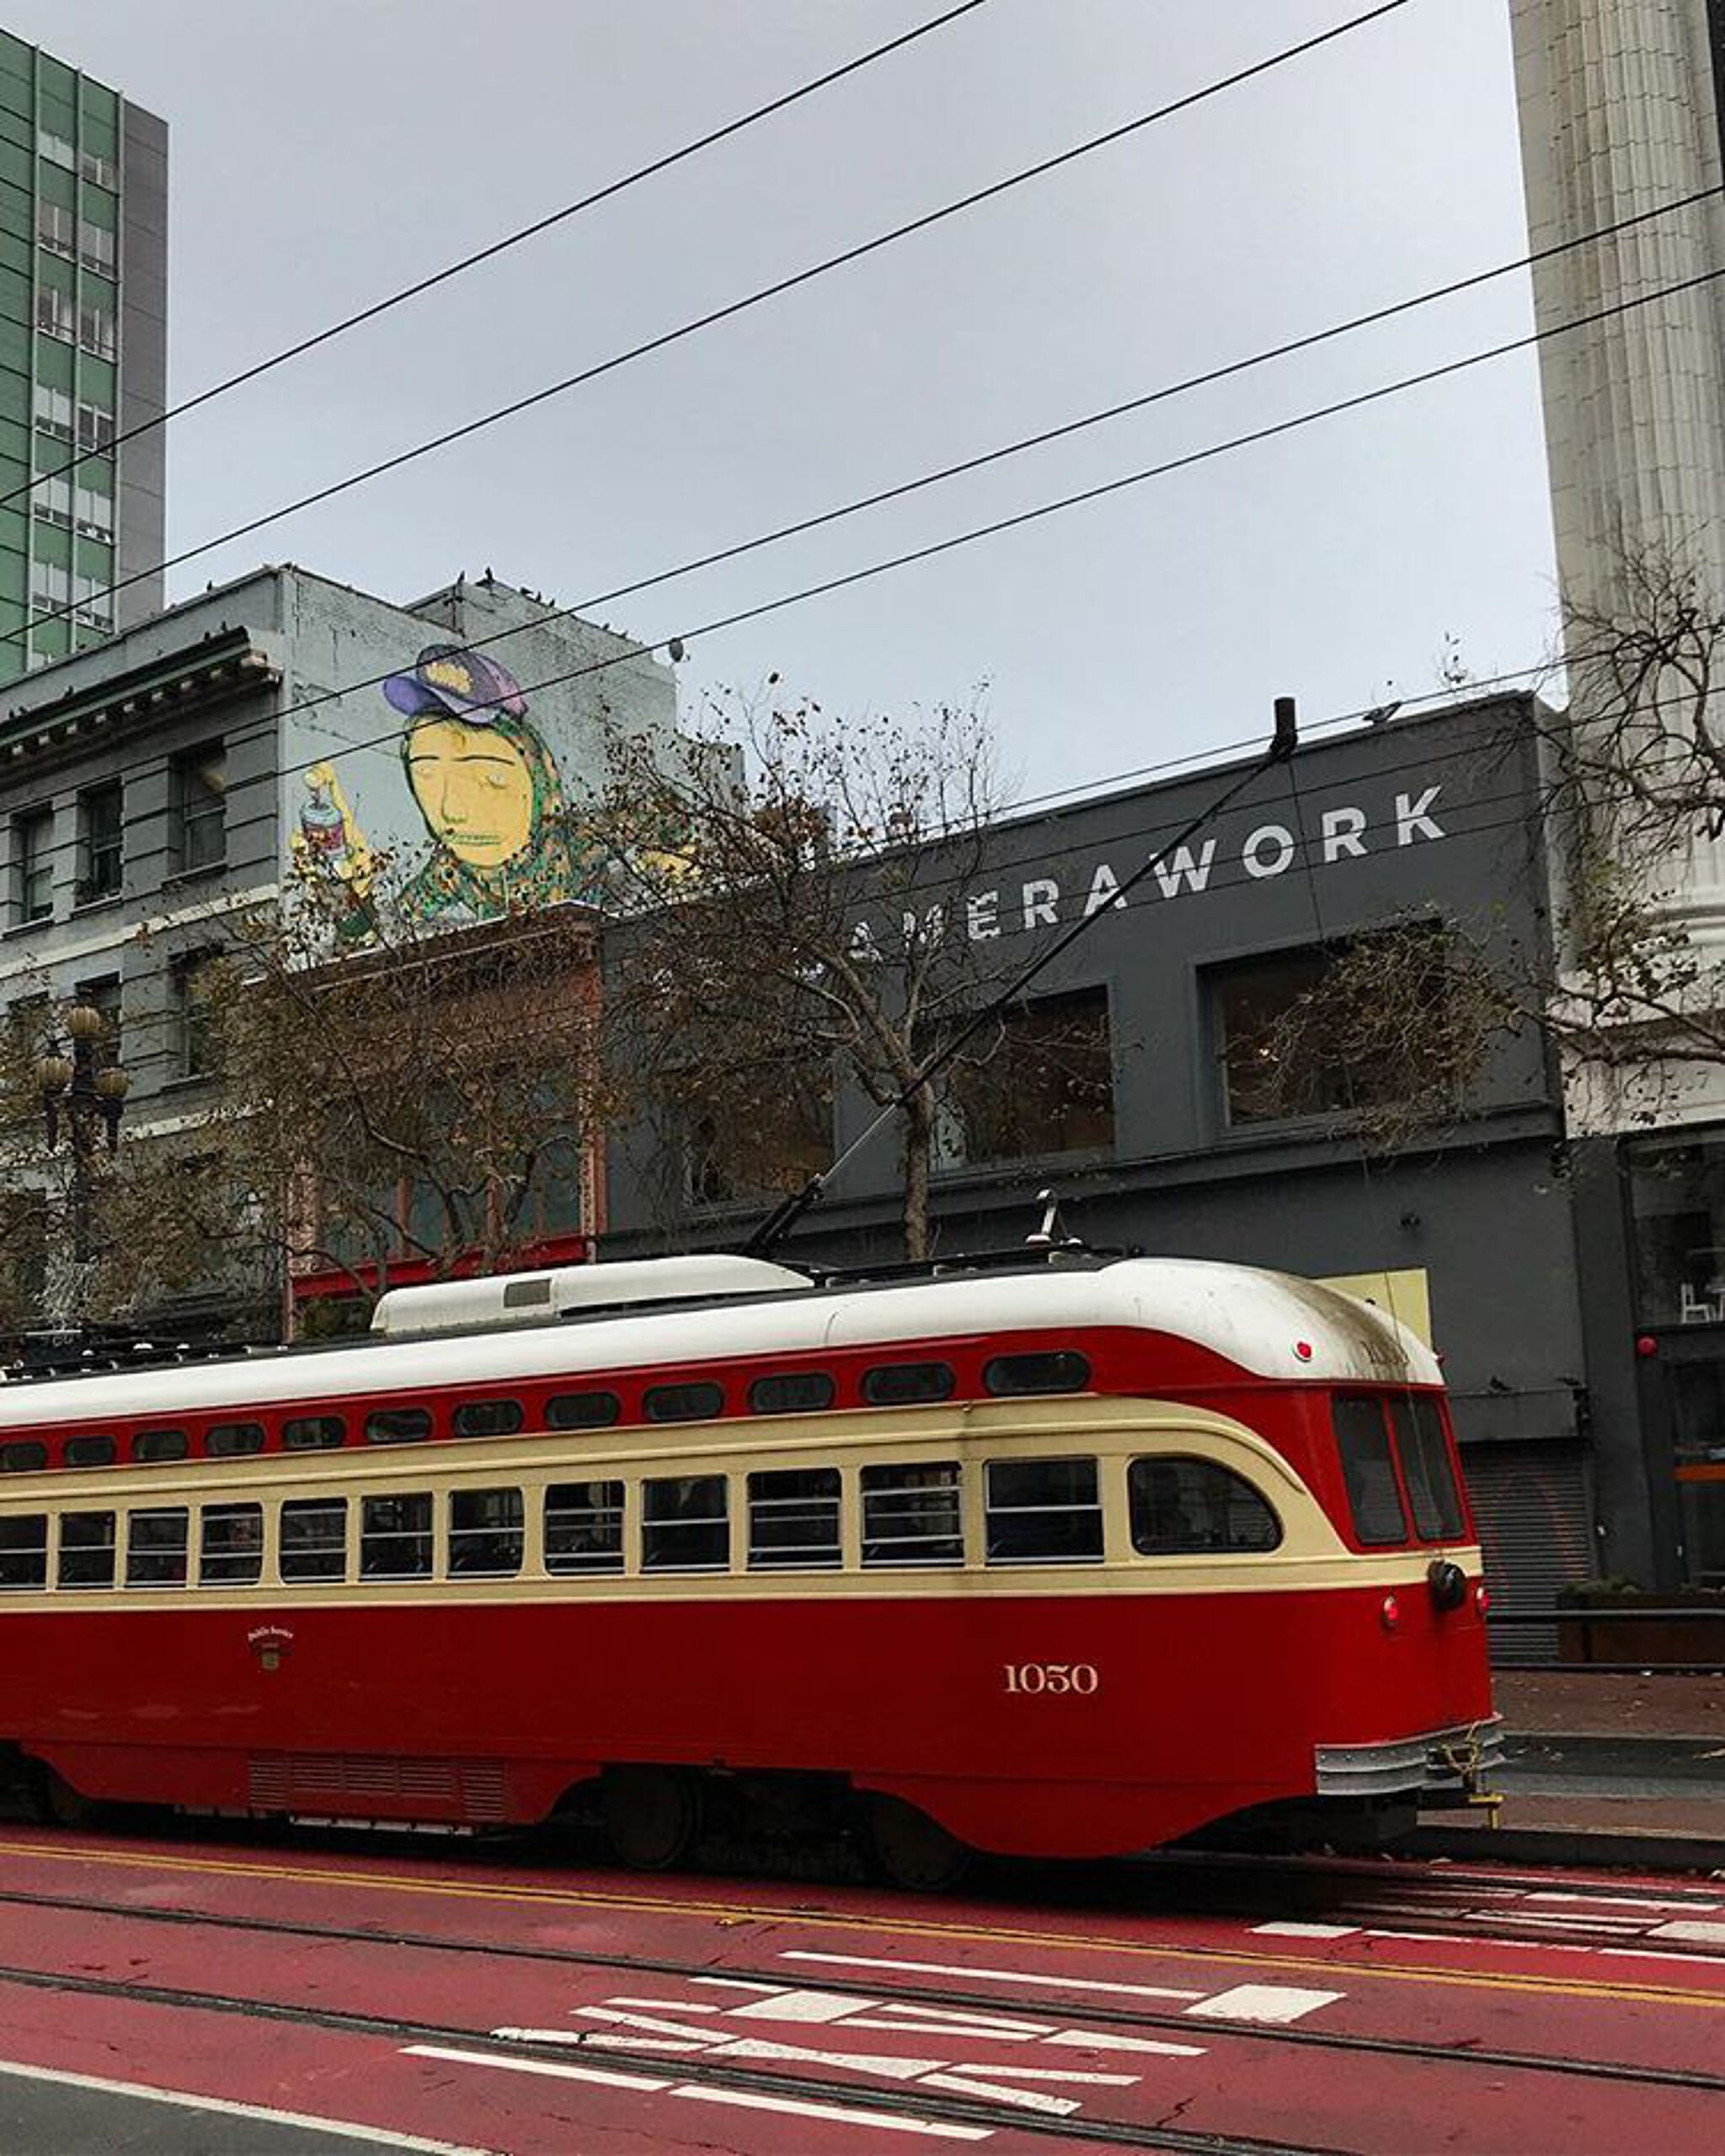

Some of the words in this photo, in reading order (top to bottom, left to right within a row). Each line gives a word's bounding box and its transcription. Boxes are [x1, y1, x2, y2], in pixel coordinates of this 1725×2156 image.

[793, 786, 1446, 981] AMERAWORK
[1003, 1663, 1098, 1694] 1050
[398, 1950, 1347, 2141] TAXI
